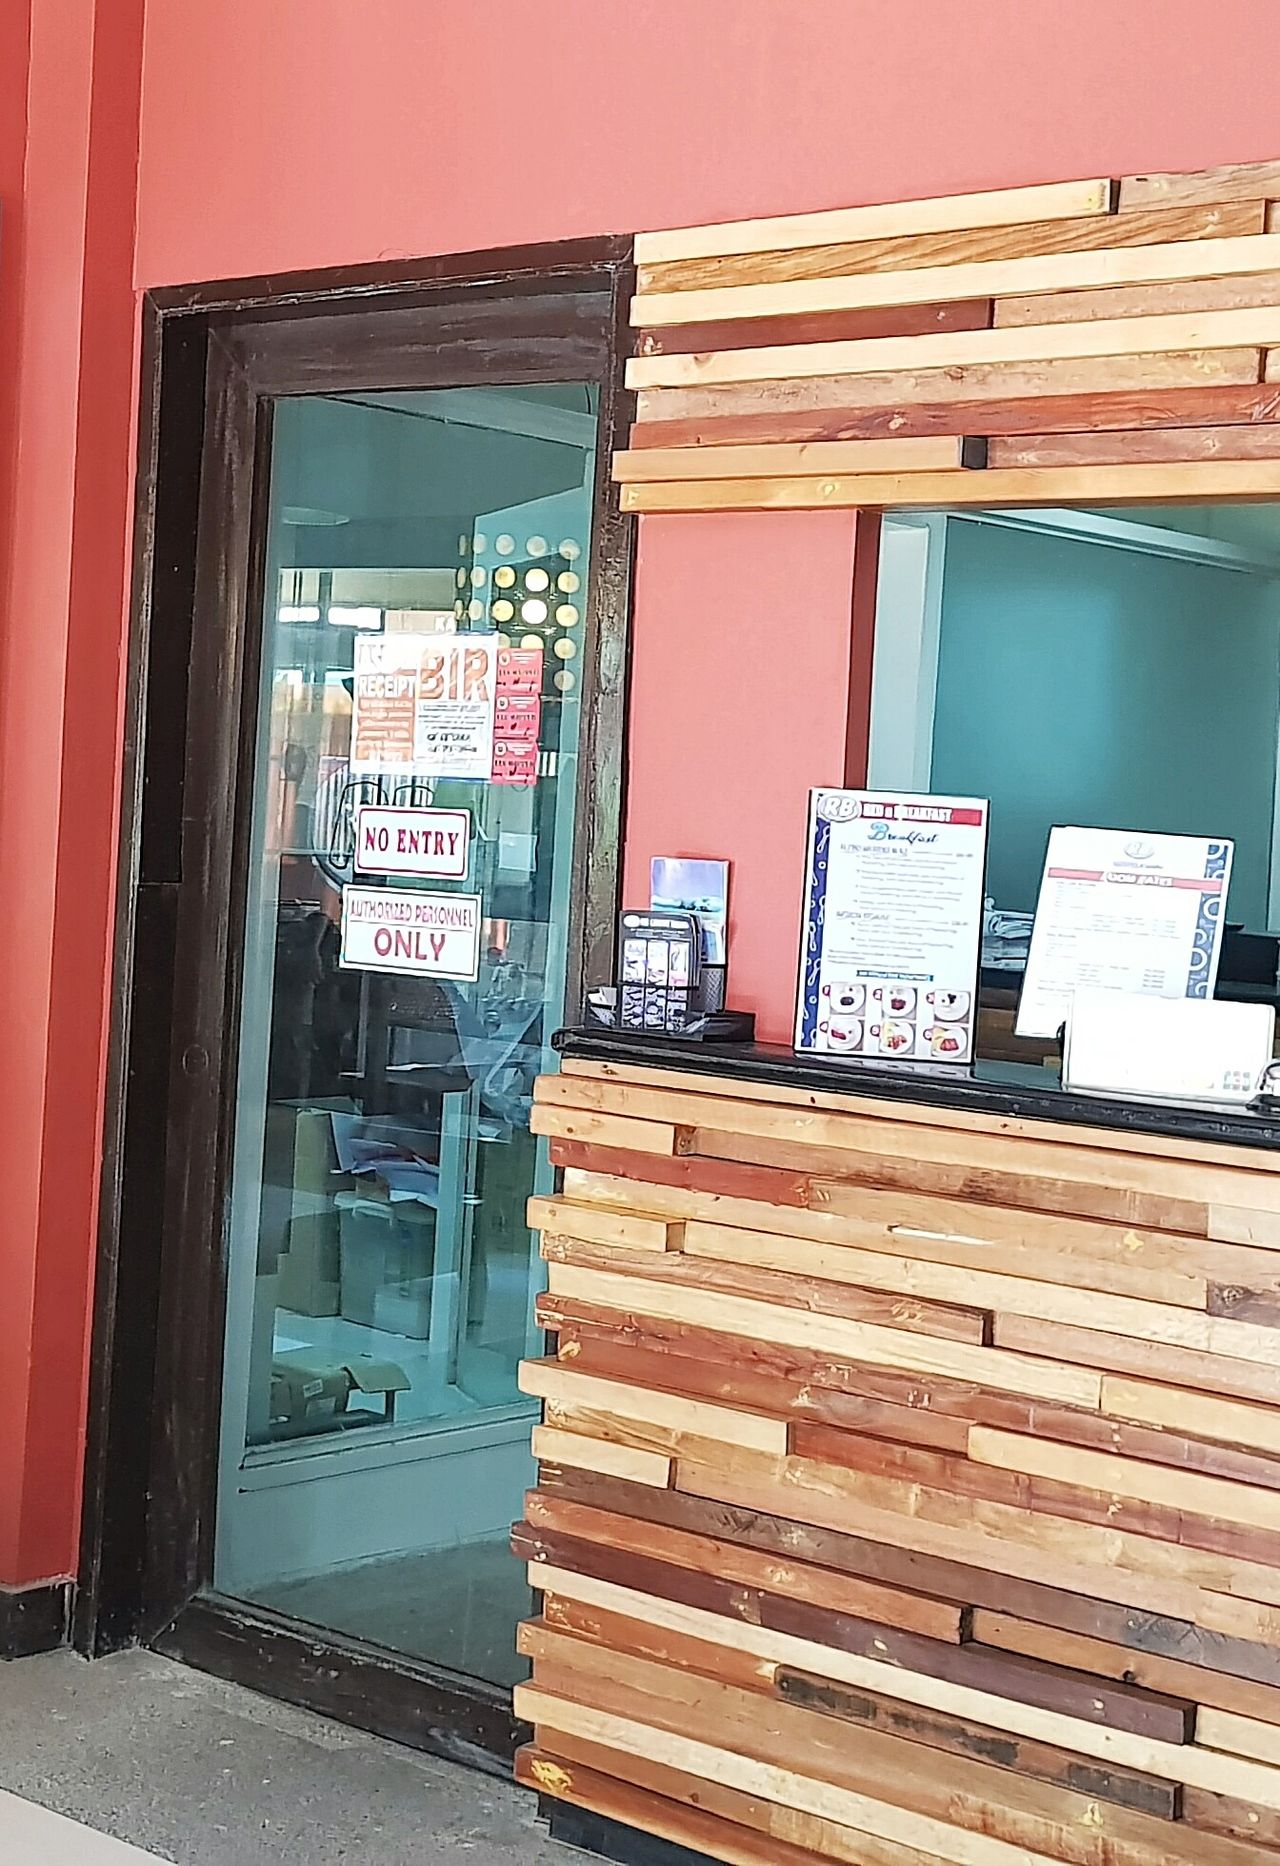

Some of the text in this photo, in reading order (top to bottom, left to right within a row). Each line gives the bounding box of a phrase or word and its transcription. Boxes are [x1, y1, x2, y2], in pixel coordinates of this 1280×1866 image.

[358, 675, 414, 698] RECEIPT
[419, 649, 488, 699] BIR
[824, 798, 856, 819] RB
[365, 827, 459, 855] NO ENTRY
[350, 900, 473, 927] AUTHORIZED PERSONNEL
[374, 928, 446, 961] ONLY
